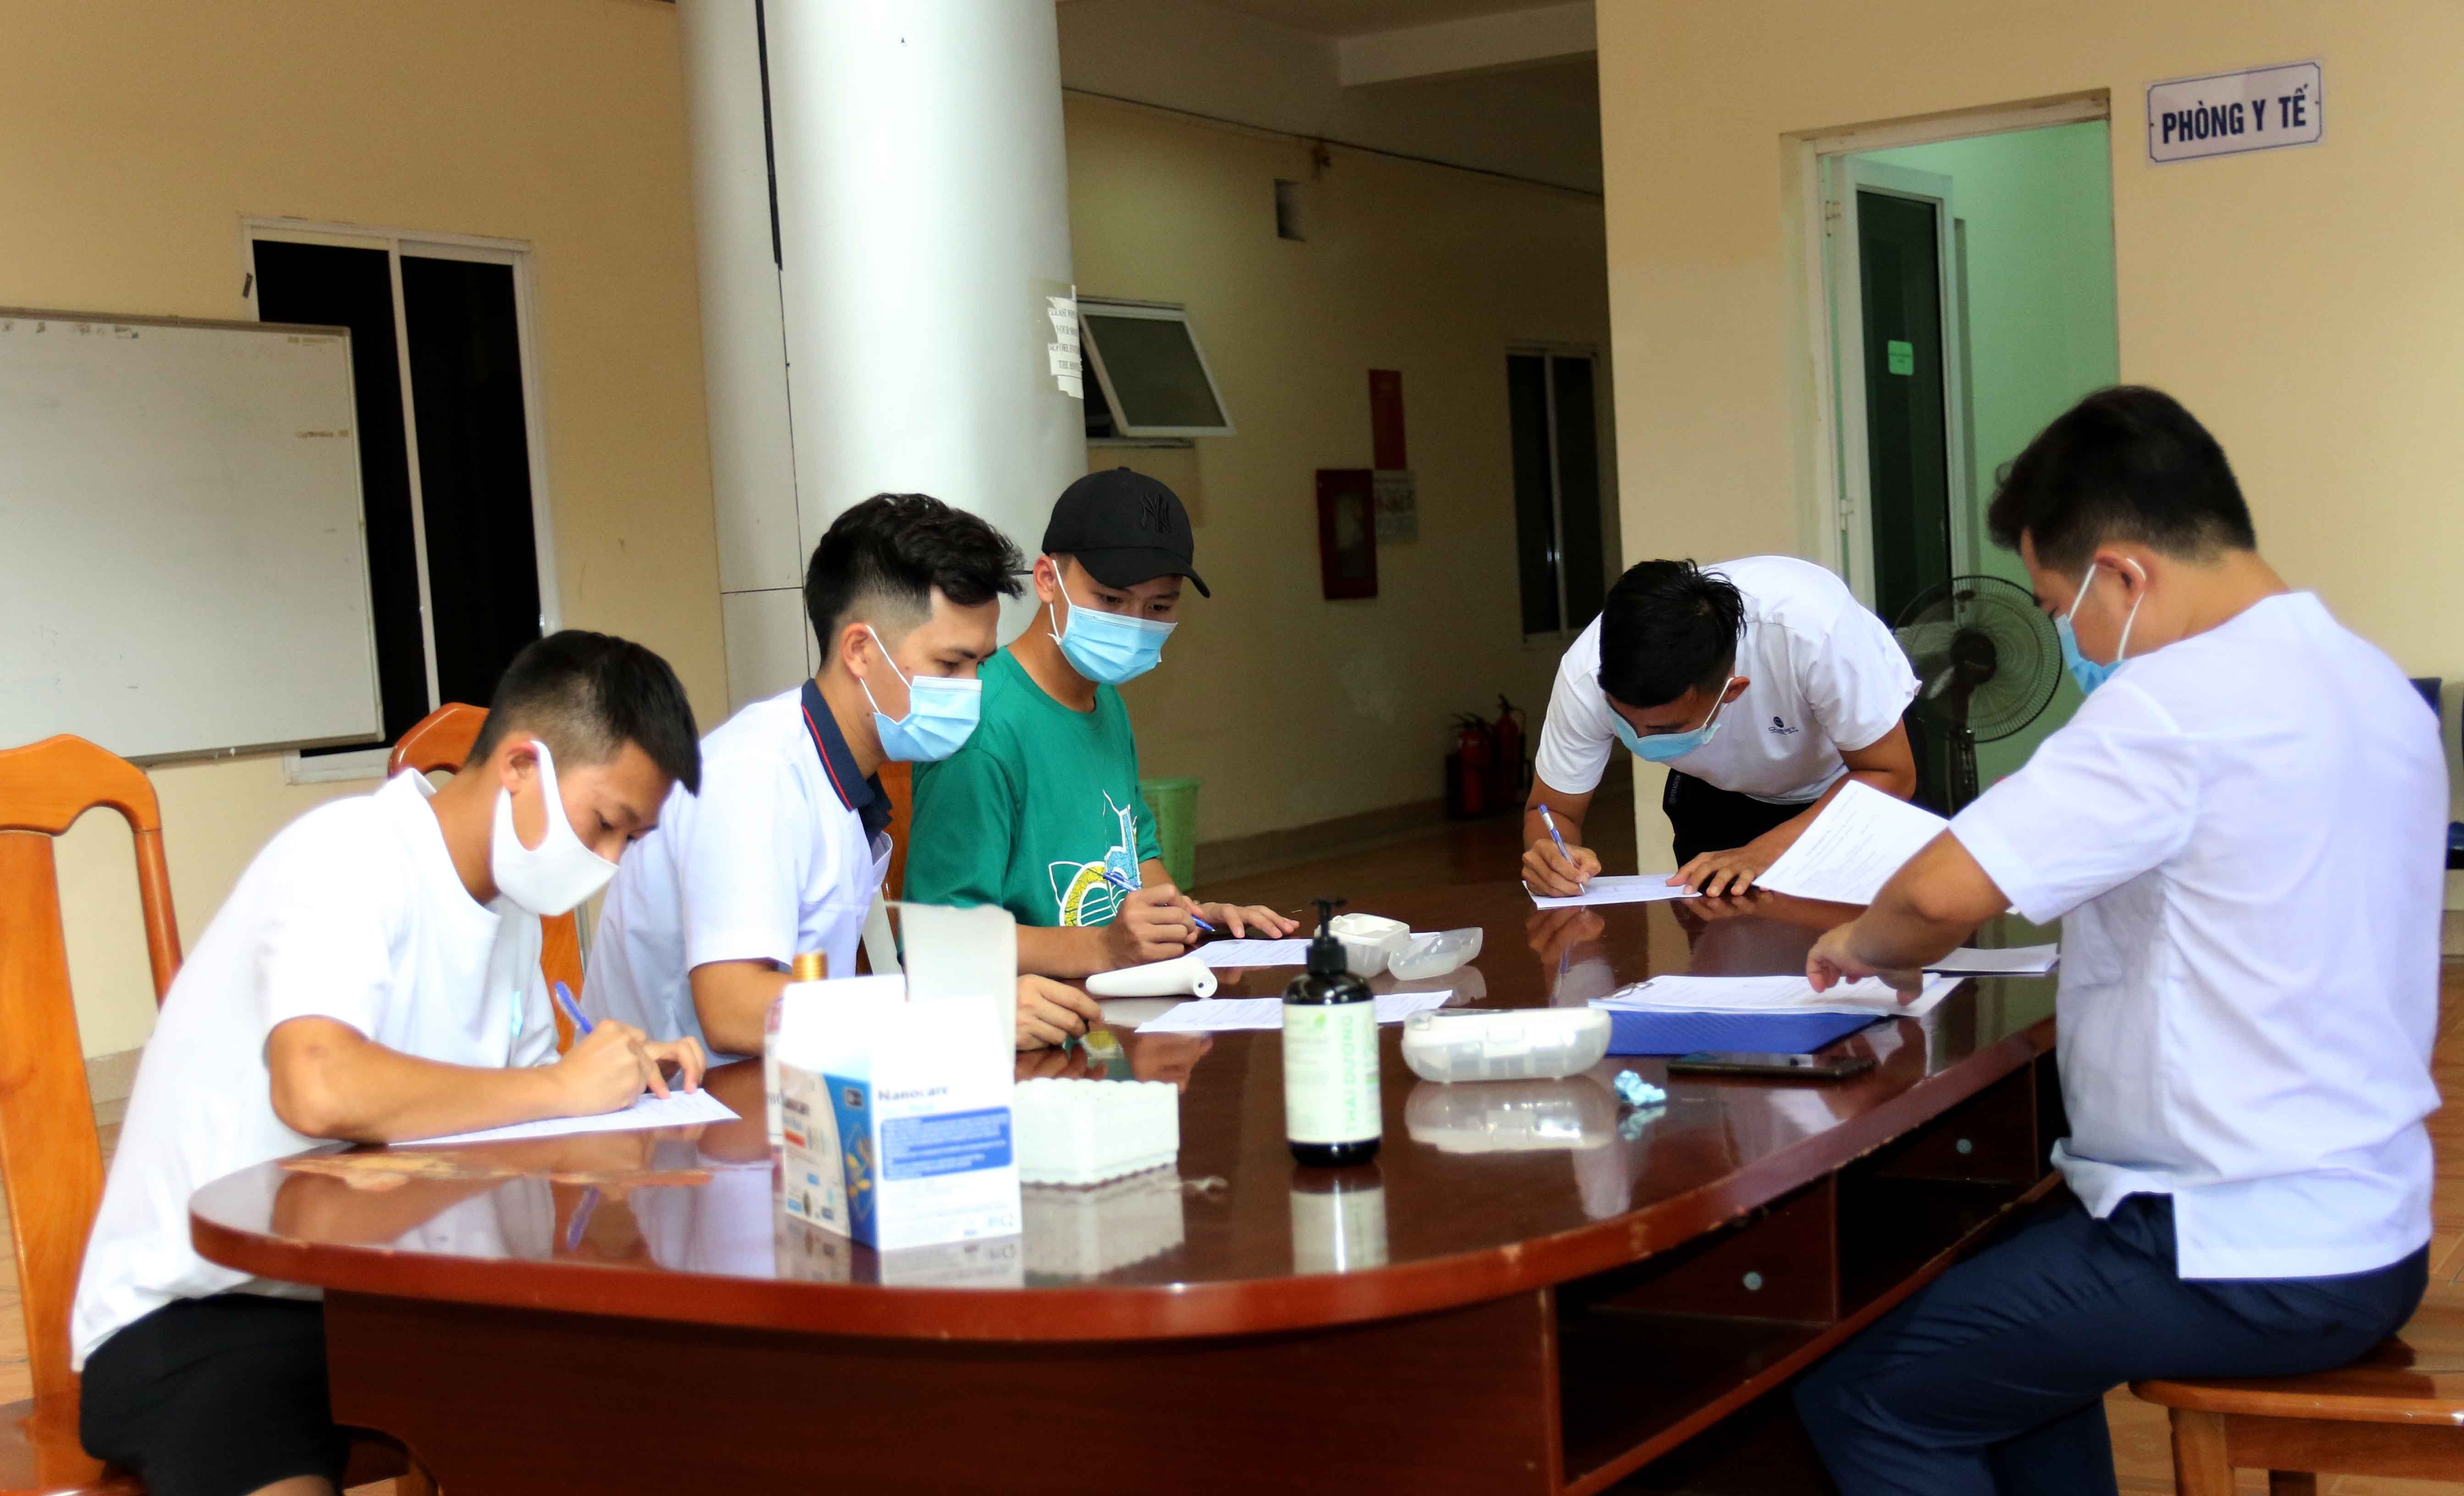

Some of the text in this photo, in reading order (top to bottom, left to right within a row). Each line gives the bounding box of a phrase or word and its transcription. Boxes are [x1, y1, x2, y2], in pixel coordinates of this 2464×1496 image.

[2162, 83, 2308, 144] PHÒNG Y TẾ
